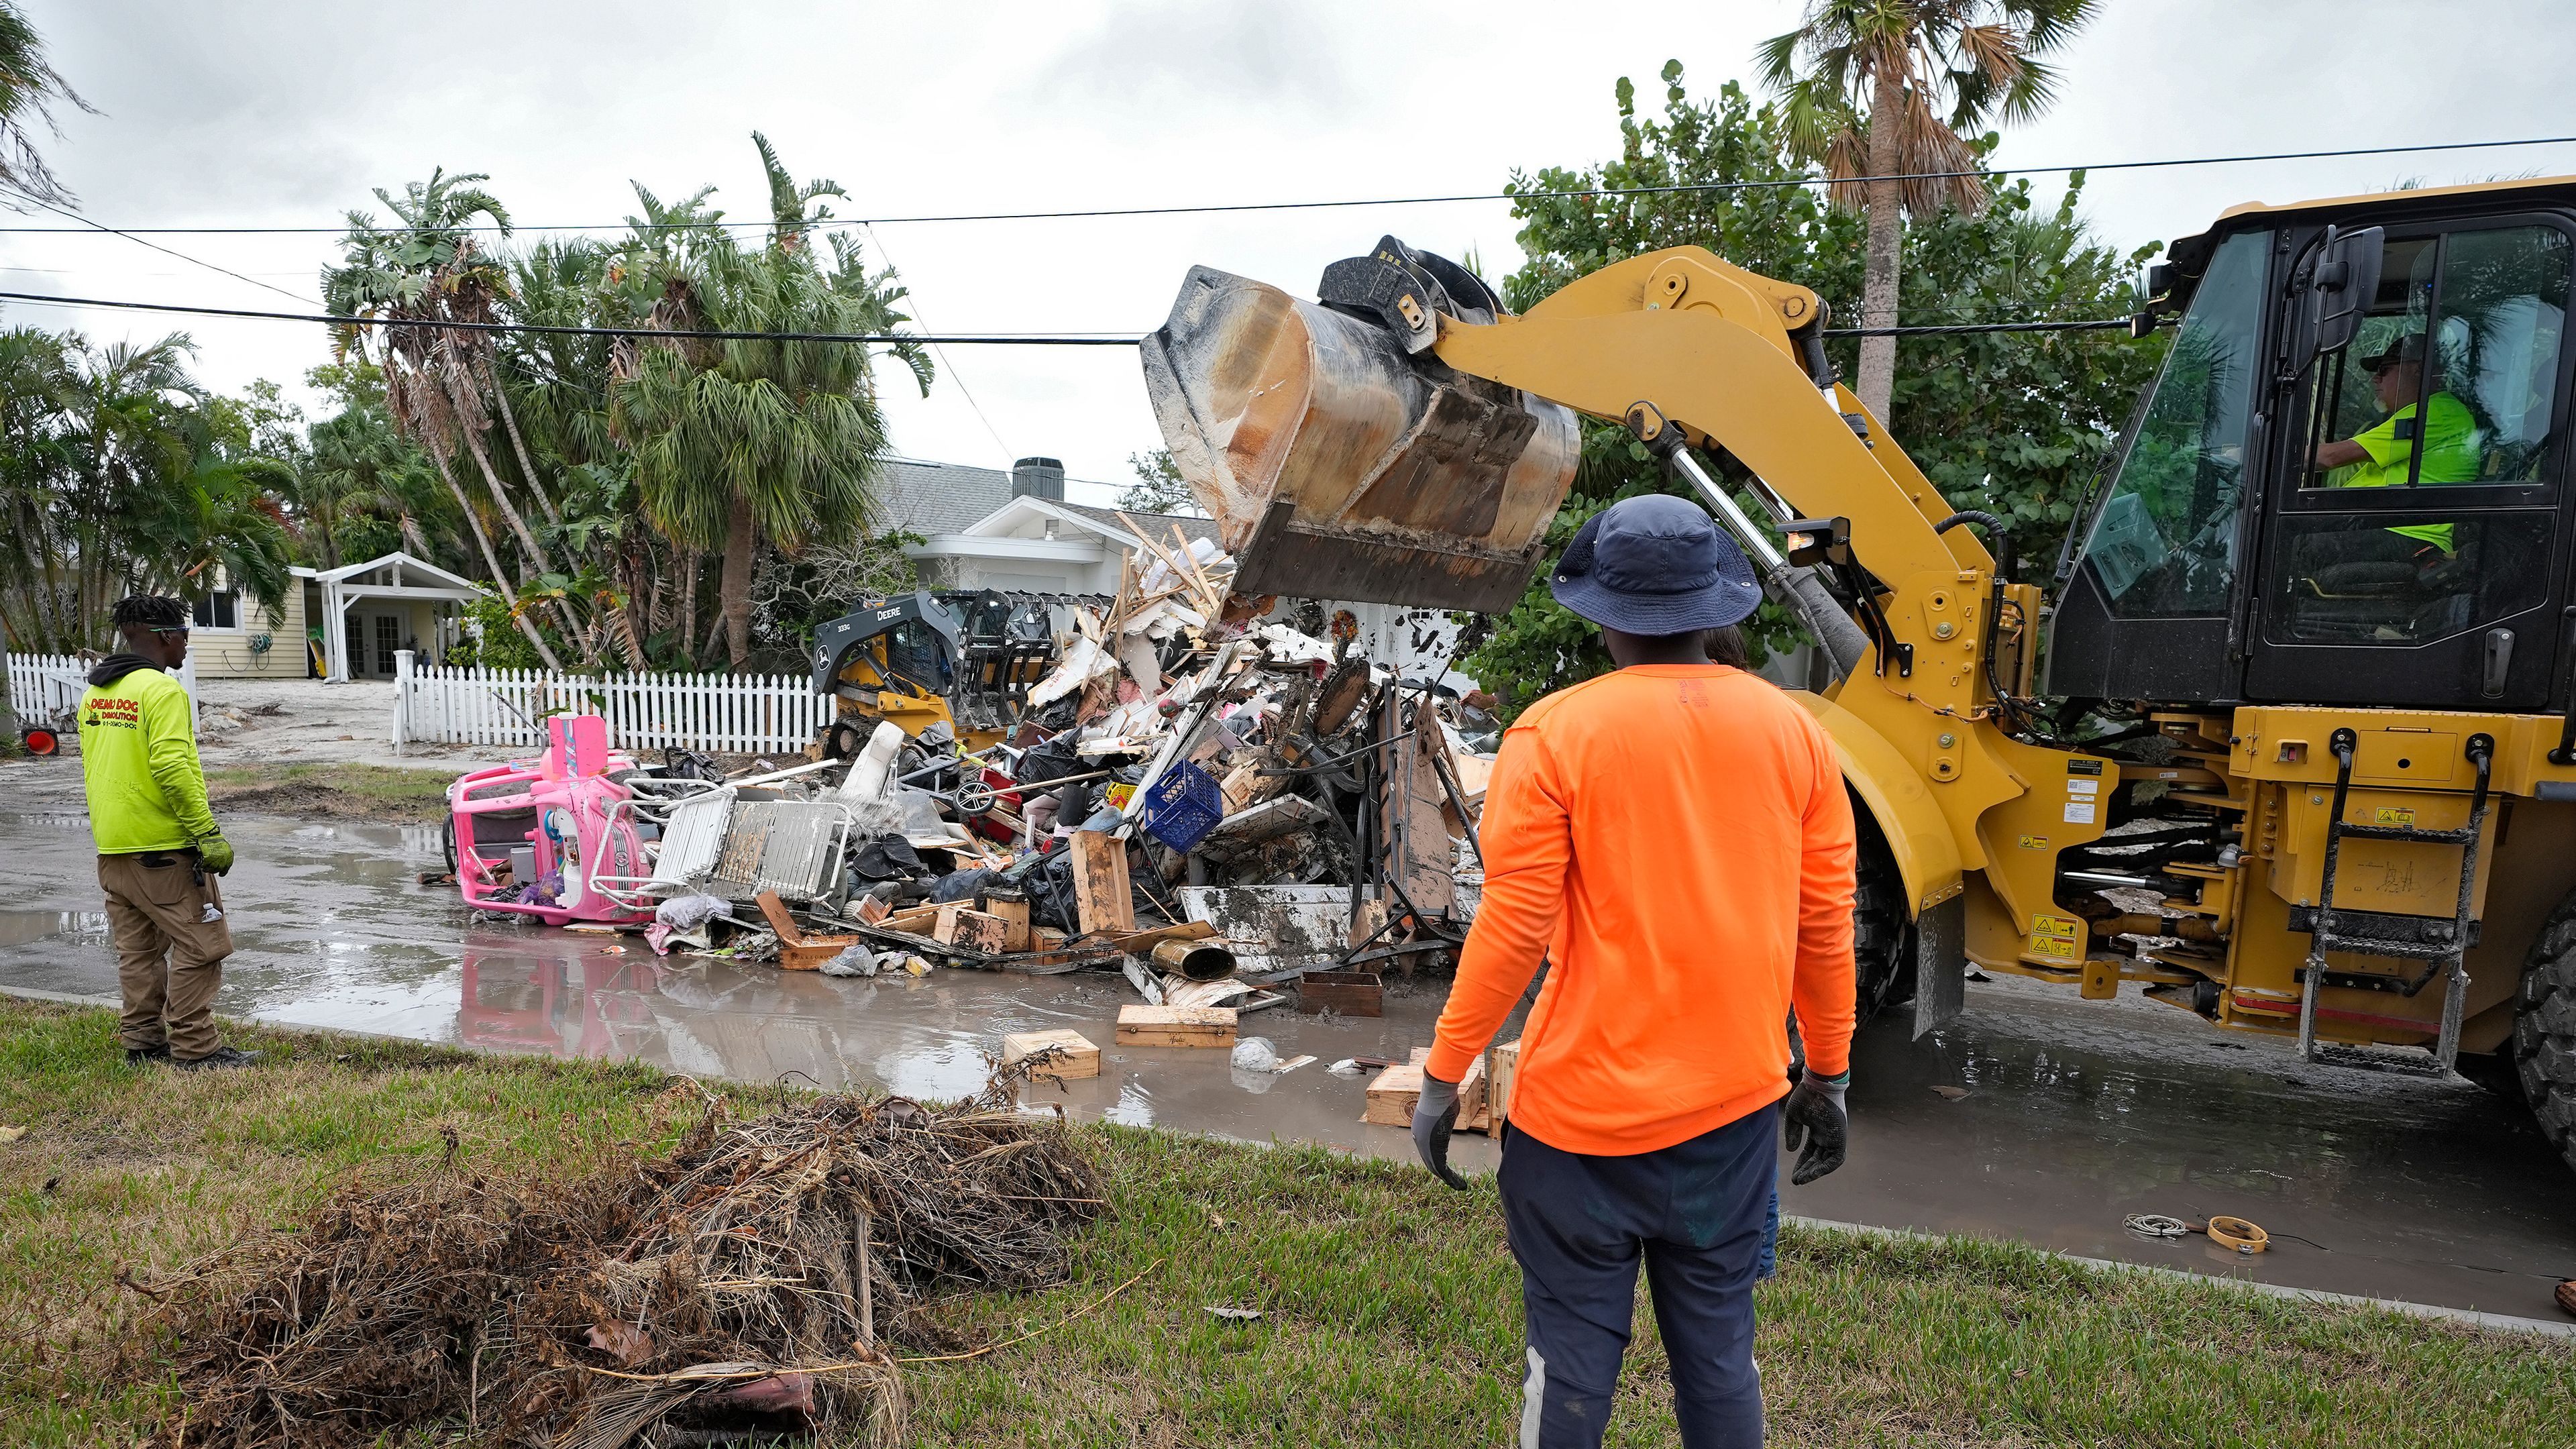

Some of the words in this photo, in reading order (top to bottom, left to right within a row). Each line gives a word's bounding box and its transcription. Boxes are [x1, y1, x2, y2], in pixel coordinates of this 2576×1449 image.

[877, 606, 901, 621] DEERE
[837, 624, 850, 633] 333G
[91, 698, 115, 710] DEMO
[116, 698, 138, 712] DOG
